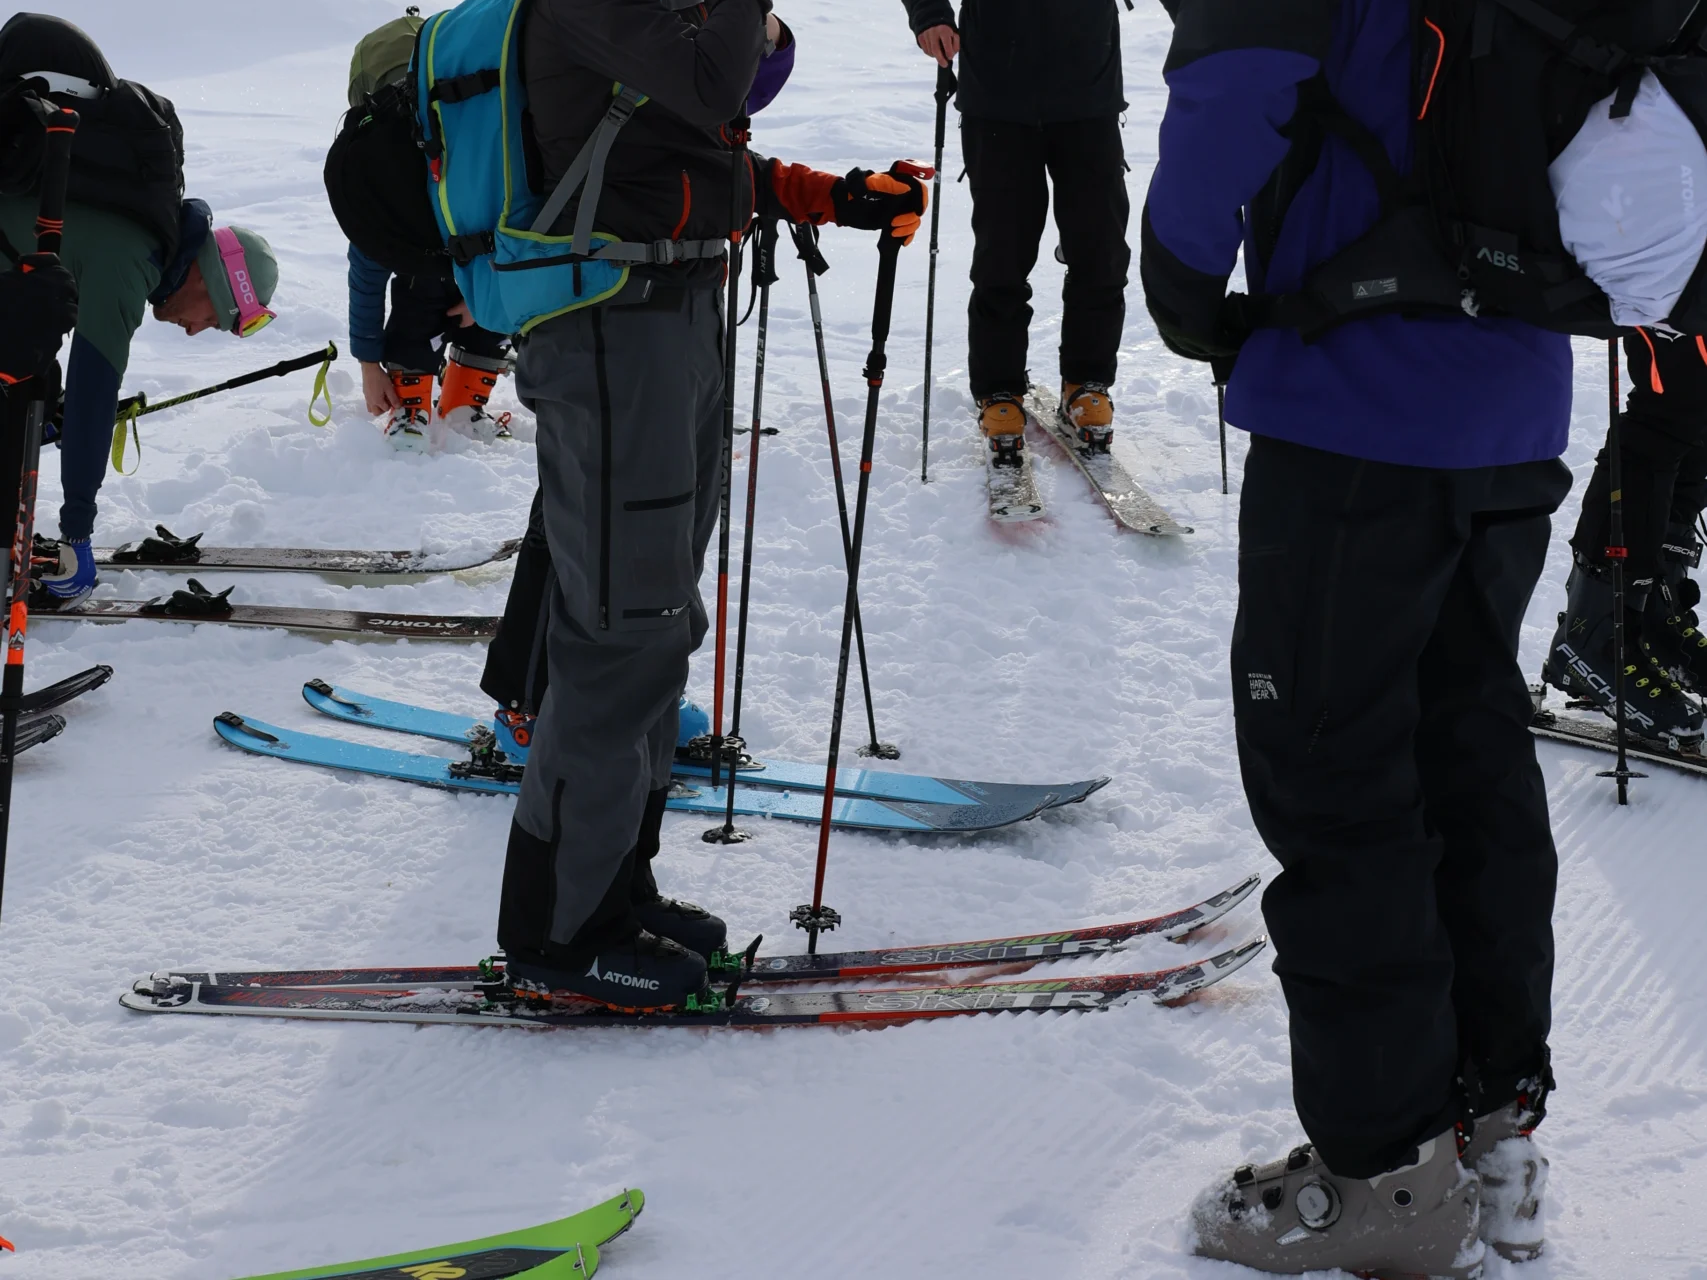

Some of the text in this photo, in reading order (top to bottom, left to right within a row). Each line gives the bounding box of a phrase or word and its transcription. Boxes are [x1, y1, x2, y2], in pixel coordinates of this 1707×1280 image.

[756, 248, 768, 274] LEKI
[234, 270, 254, 304] POC
[367, 618, 464, 629] ATOMIC
[1250, 689, 1271, 700] WEAR
[1555, 642, 1655, 731] FISCHER
[602, 970, 660, 991] ATOMIC
[1281, 1231, 1309, 1245] ATOMIC
